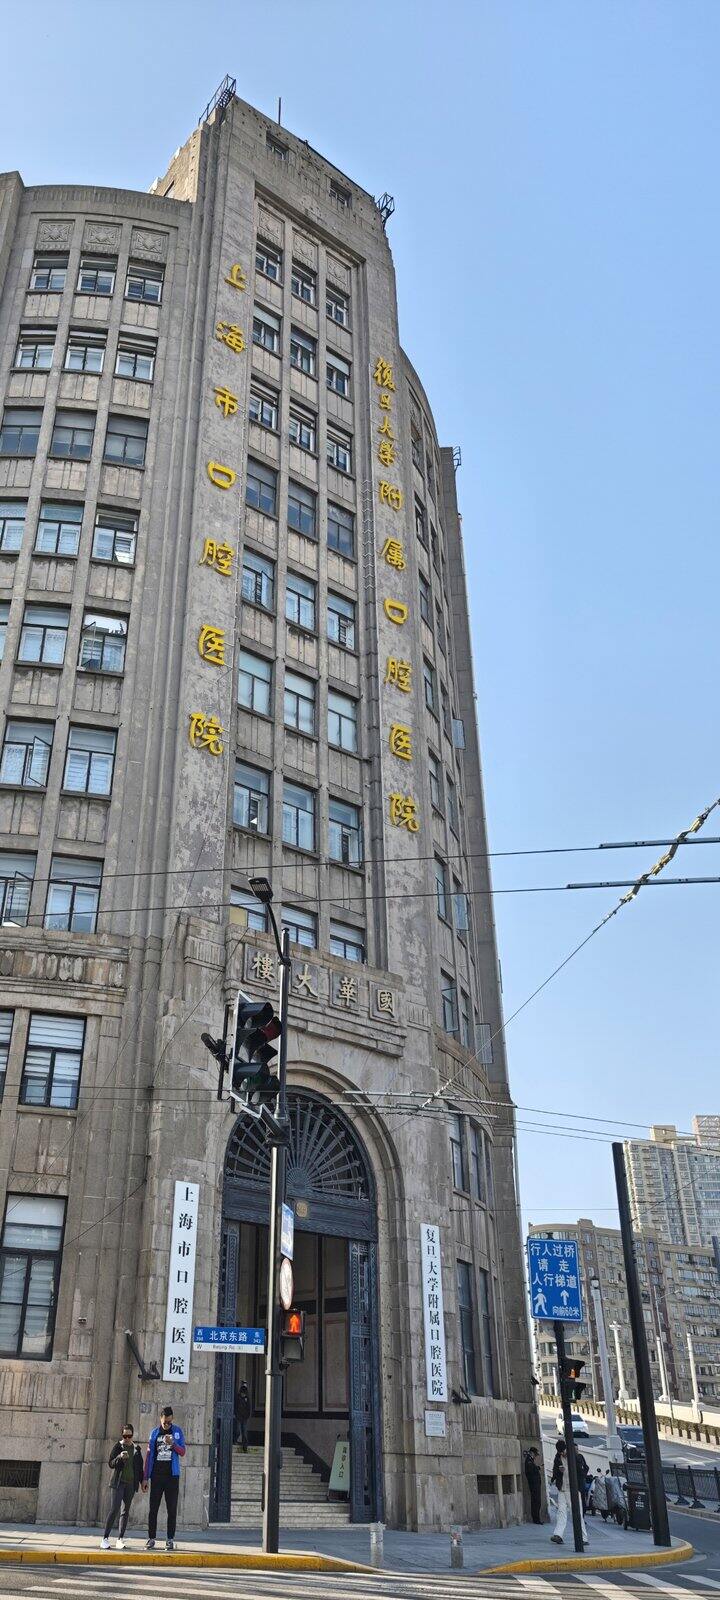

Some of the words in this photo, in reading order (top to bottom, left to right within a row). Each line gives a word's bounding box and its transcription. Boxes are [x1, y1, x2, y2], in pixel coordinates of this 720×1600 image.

[188, 263, 246, 756] 上海市口腔医院
[530, 1243, 575, 1258] 行人过桥
[538, 1258, 549, 1272] 请
[558, 1259, 570, 1273] 走
[169, 1186, 194, 1375] 上海市口腔医院
[532, 1273, 578, 1289] 人行梯道
[425, 1228, 444, 1396] 复旦大学附属口腔医院
[209, 1330, 248, 1342] 北京东路
